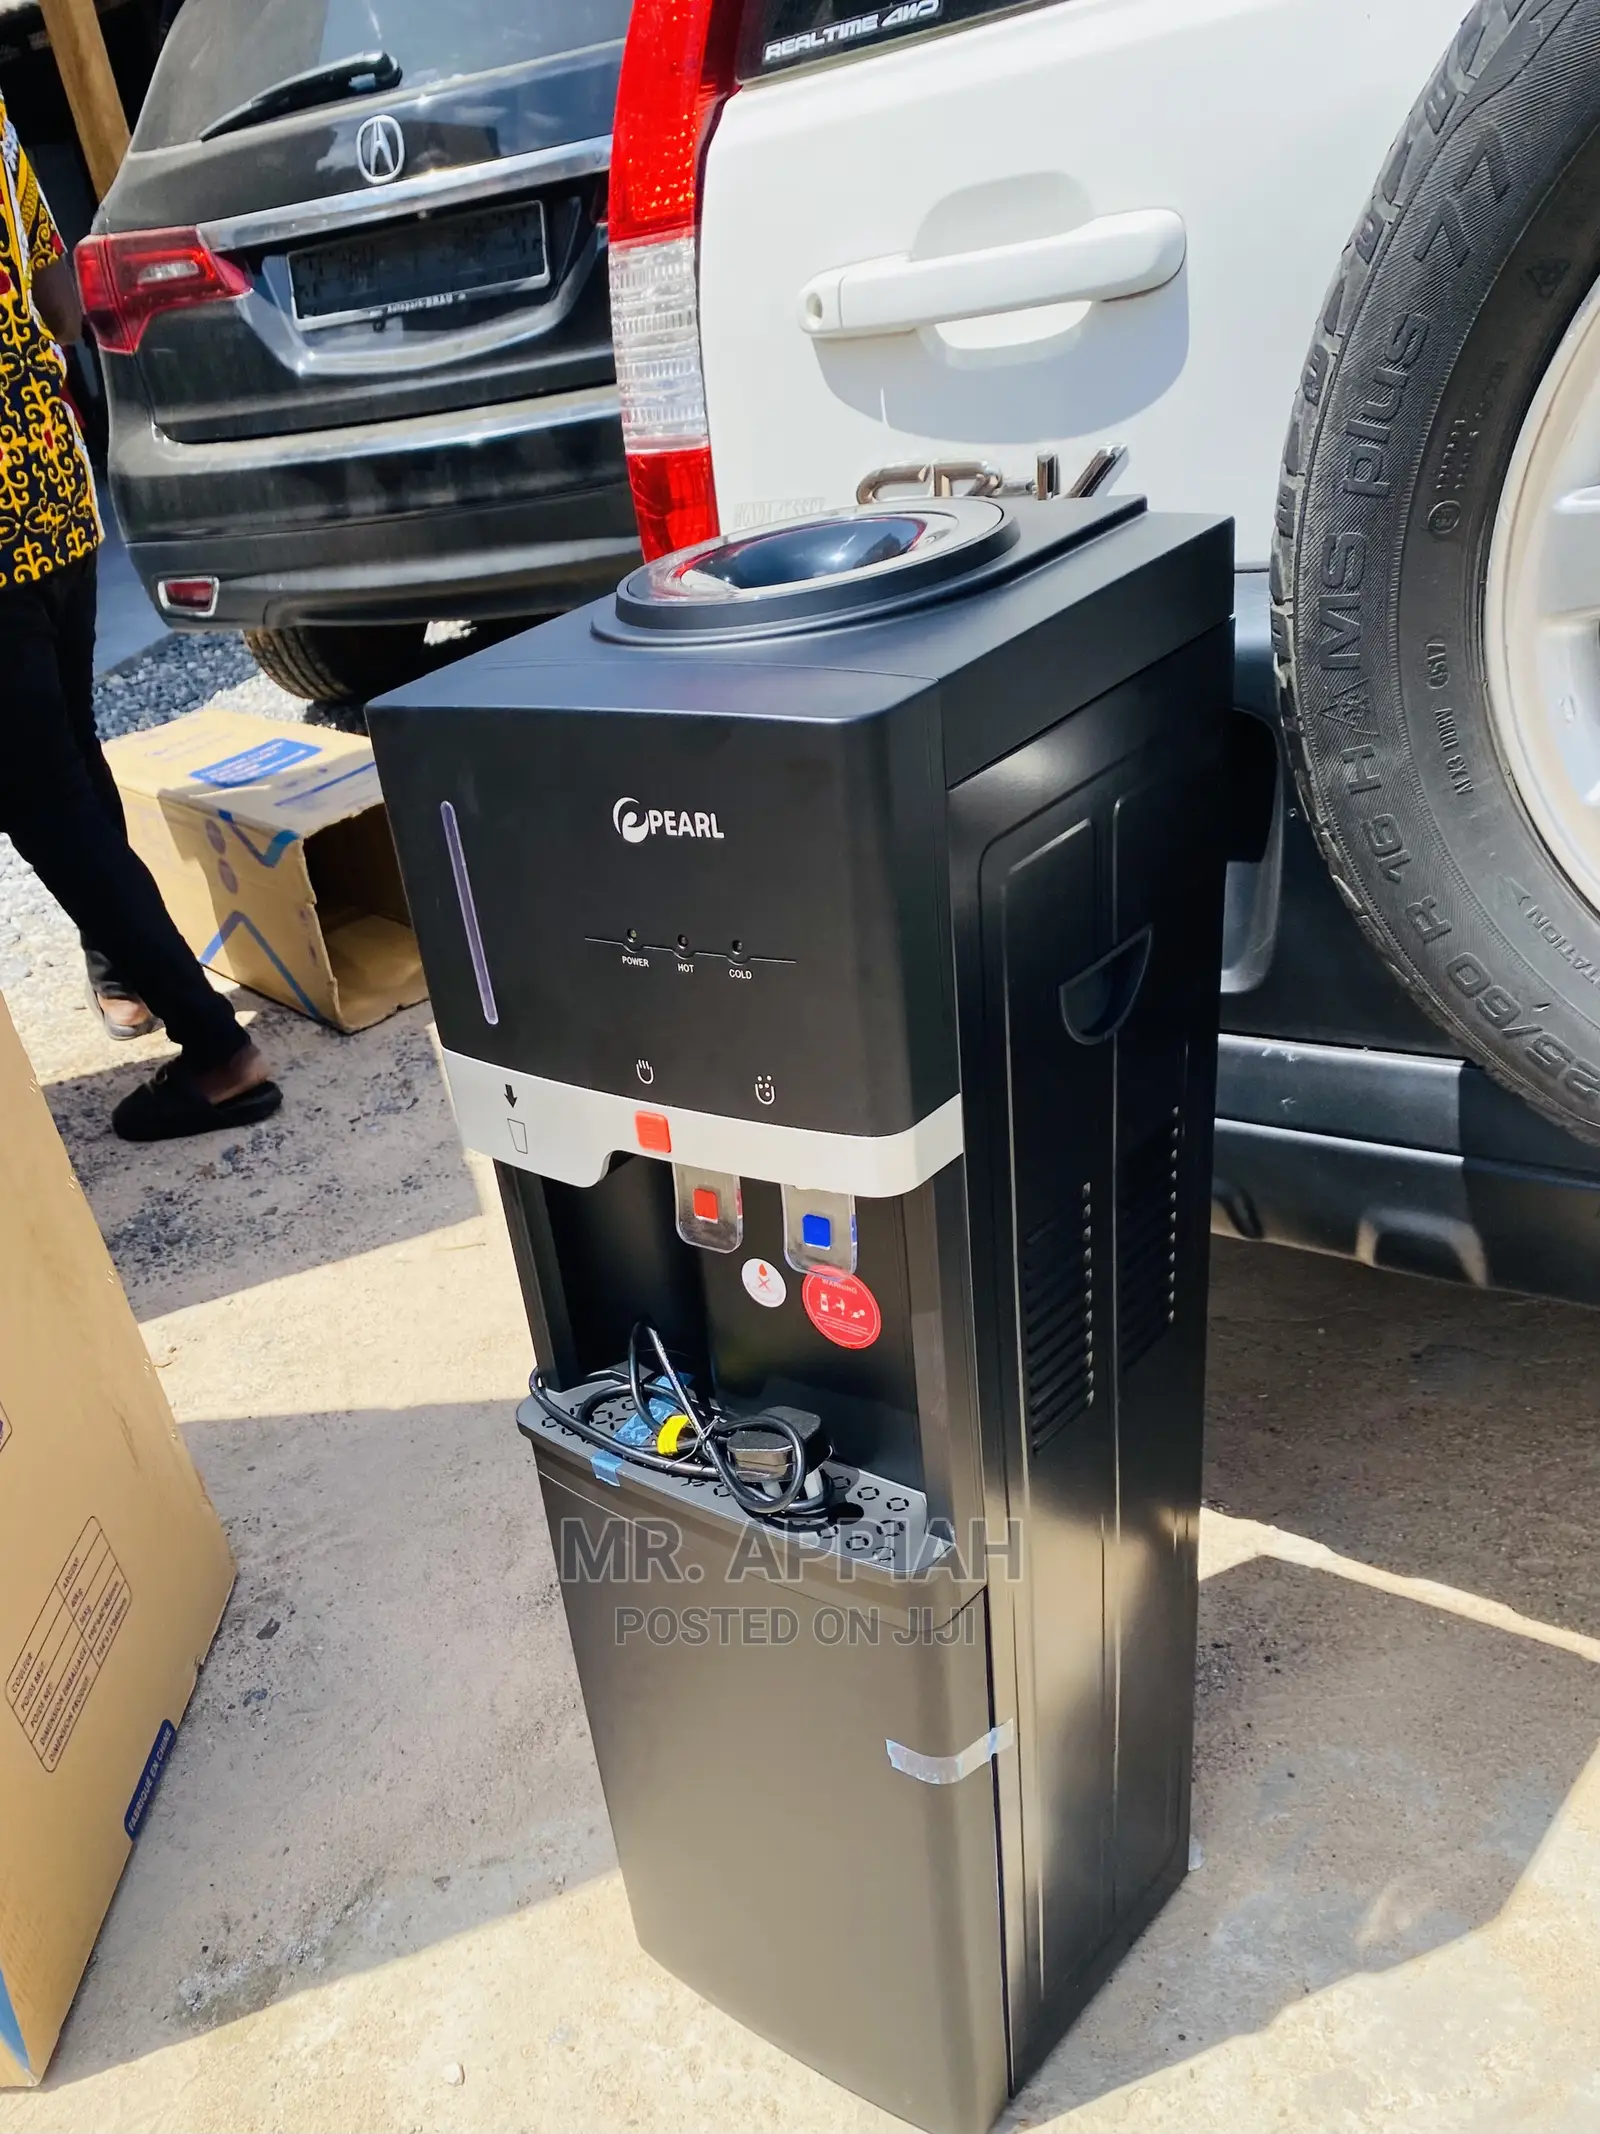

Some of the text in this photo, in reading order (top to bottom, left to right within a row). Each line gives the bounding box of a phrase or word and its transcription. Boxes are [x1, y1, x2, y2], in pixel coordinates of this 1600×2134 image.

[1412, 132, 1511, 268] 77
[1342, 311, 1430, 498] plus
[1318, 531, 1368, 671] MS
[648, 809, 725, 839] PEARL
[1361, 813, 1412, 884] 16
[1405, 895, 1452, 944] R
[621, 955, 650, 968] POWER
[677, 963, 694, 973] HOT
[729, 968, 752, 979] COLD
[149, 1760, 161, 1779] EN
[156, 1726, 173, 1761] CHINE
